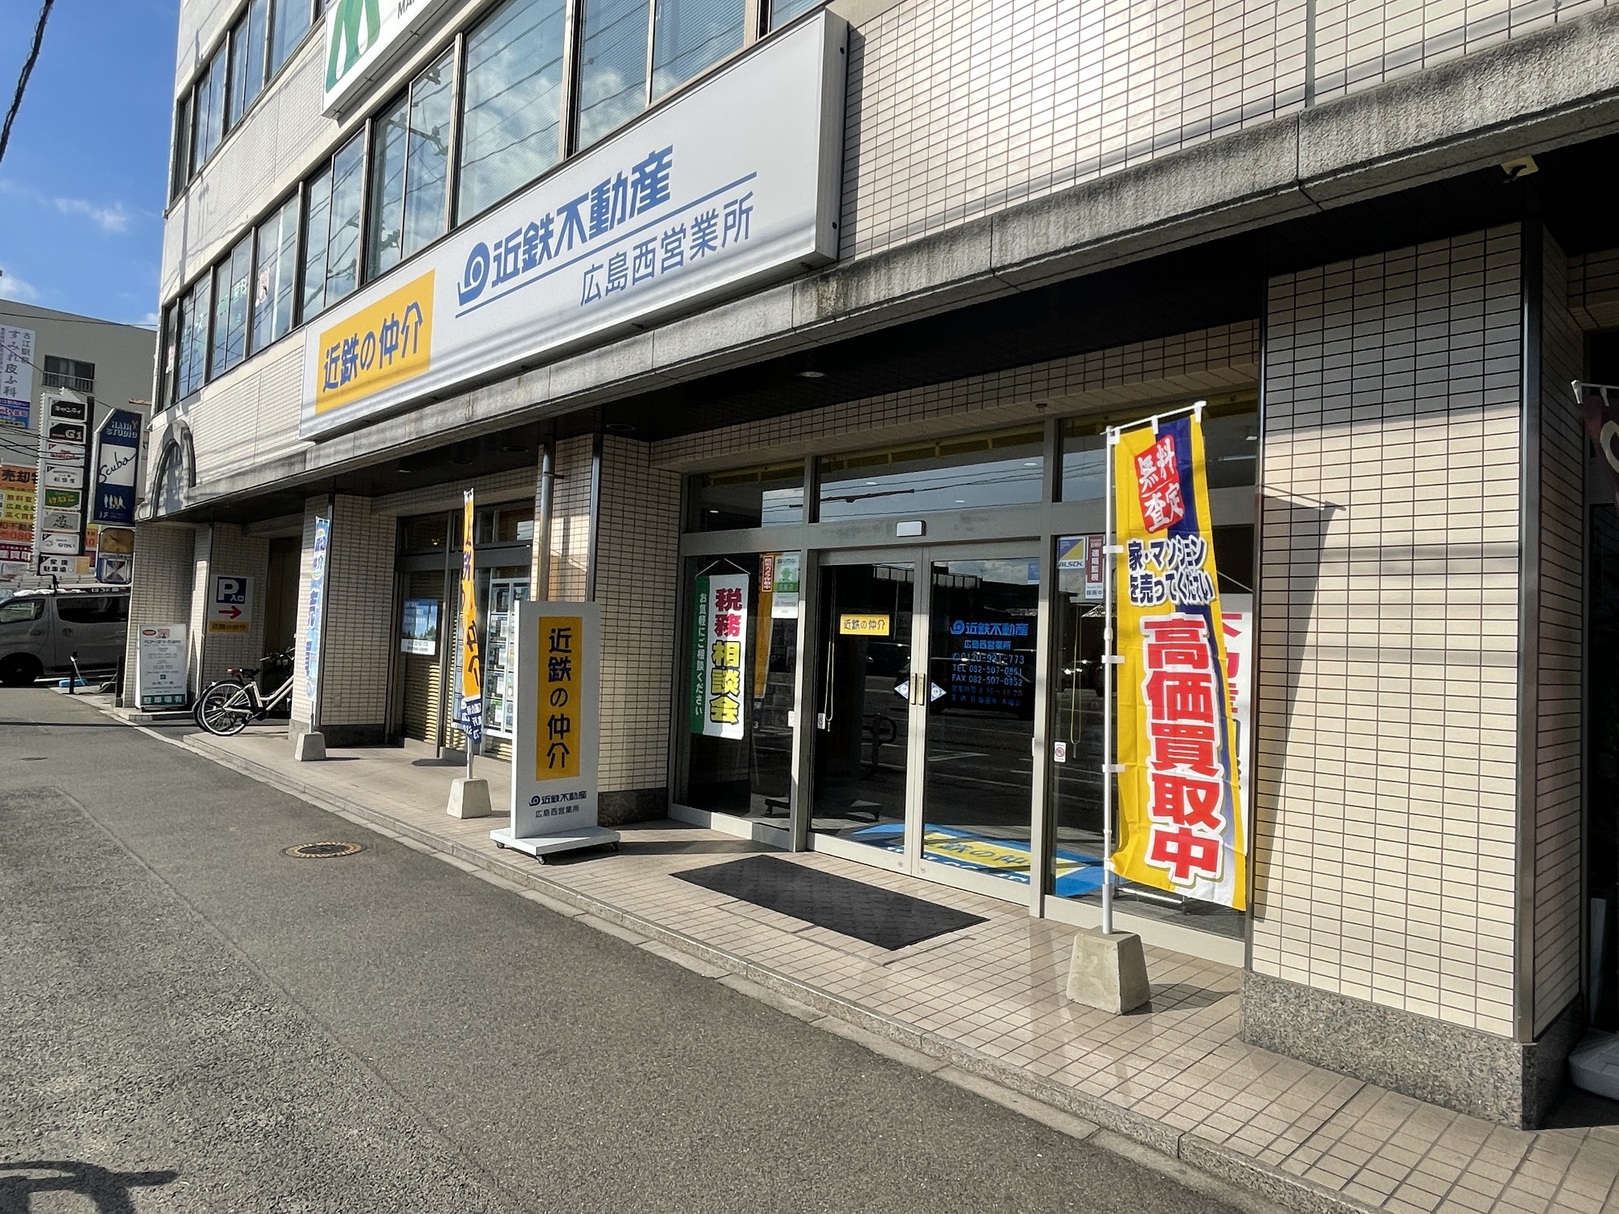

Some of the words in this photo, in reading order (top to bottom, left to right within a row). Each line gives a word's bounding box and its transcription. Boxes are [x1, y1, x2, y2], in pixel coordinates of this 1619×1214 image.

[492, 145, 674, 286] 近鉄不動産
[581, 191, 754, 307] 広島西営業所
[322, 301, 424, 393] 近鉄の仲介
[65, 429, 82, 440] G1
[106, 427, 138, 439] STUDIO
[99, 452, 137, 483] Scuba
[1138, 437, 1176, 493] 無料
[1144, 482, 1185, 532] 査定
[1058, 560, 1083, 568] ALSOK
[218, 579, 239, 600] P
[843, 618, 885, 630] 近鉄の仲介
[965, 622, 1029, 636] 近鉄不動産
[963, 639, 1012, 651] 広島西営業所
[709, 587, 743, 725] 税務相談会
[953, 663, 967, 673] TEL
[952, 673, 967, 682] FAX
[547, 626, 573, 770] 近鉄の仲介
[1144, 619, 1221, 880] 高価買取中
[541, 790, 587, 805] 近鉄不動産
[535, 805, 580, 818] 広島西営業所
